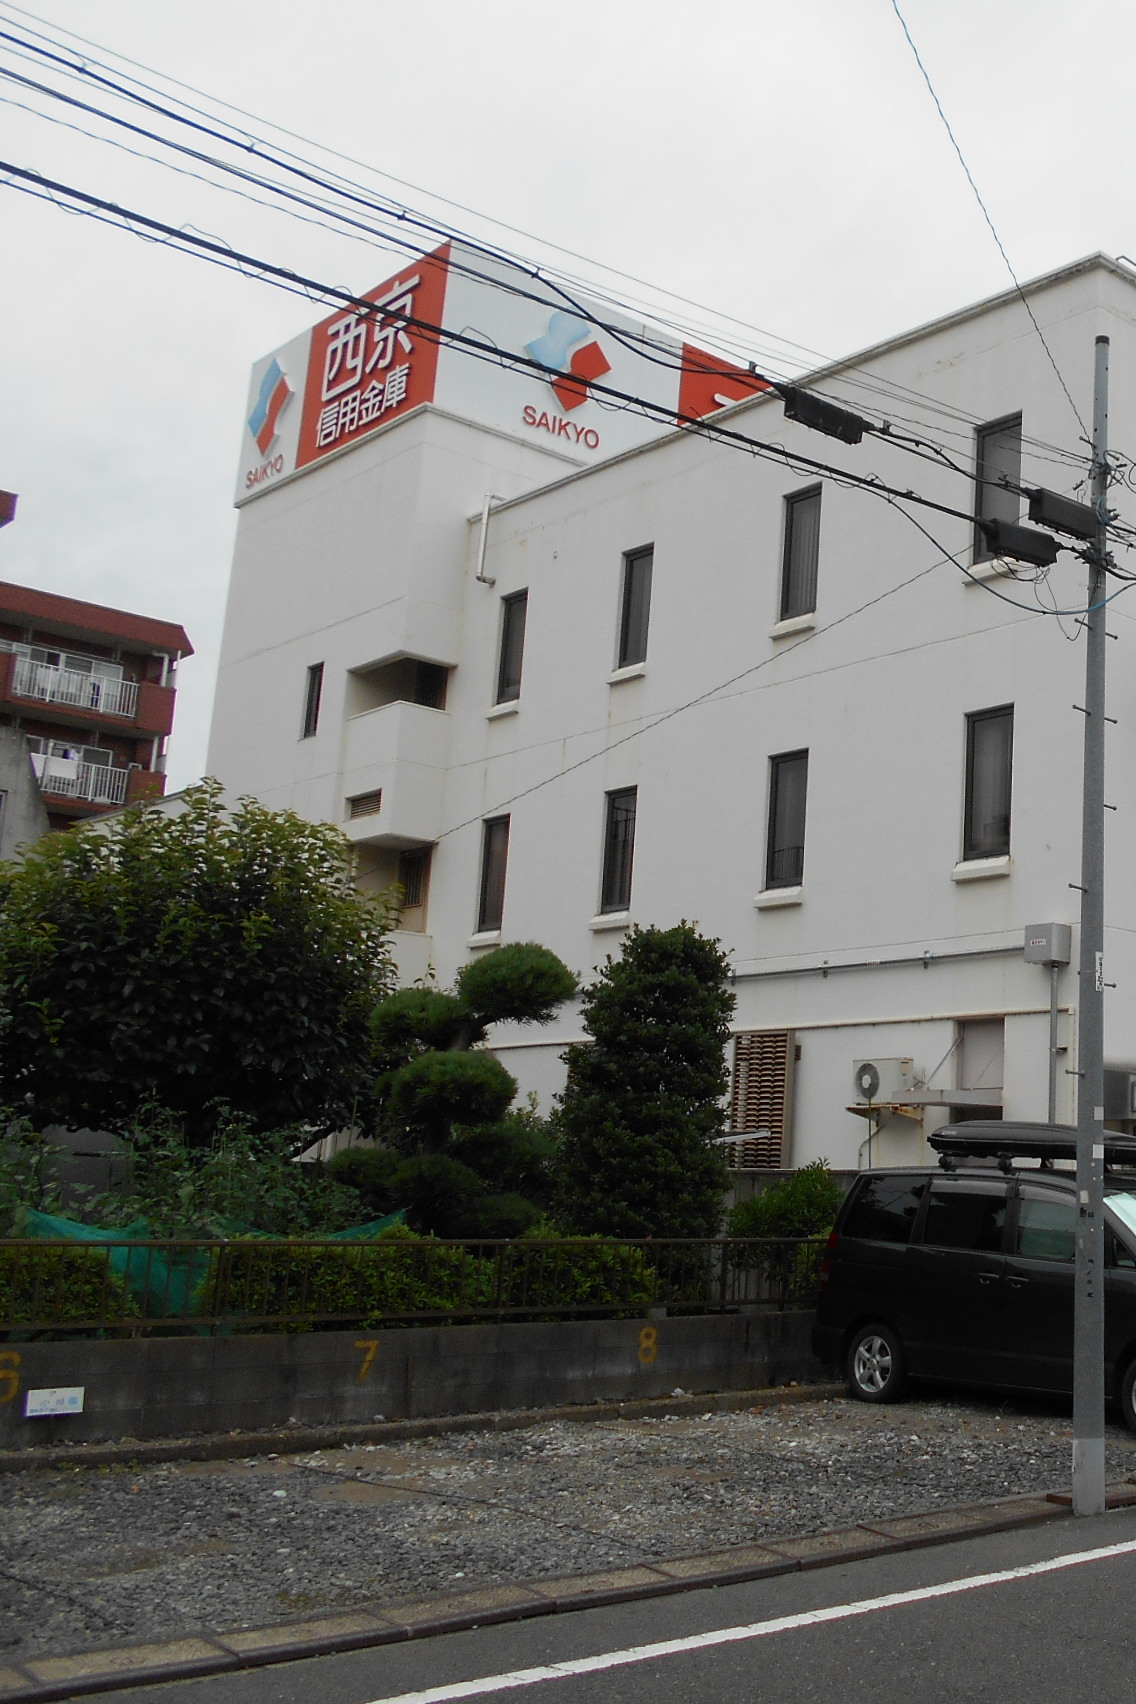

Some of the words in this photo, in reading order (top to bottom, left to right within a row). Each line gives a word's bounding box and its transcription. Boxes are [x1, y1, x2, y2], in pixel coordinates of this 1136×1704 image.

[321, 274, 421, 402] 西京
[316, 363, 410, 448] 信用金庫
[522, 405, 600, 449] SAIKYO
[245, 453, 284, 488] SAIKYO
[353, 1340, 380, 1382] 7
[638, 1326, 657, 1364] 8
